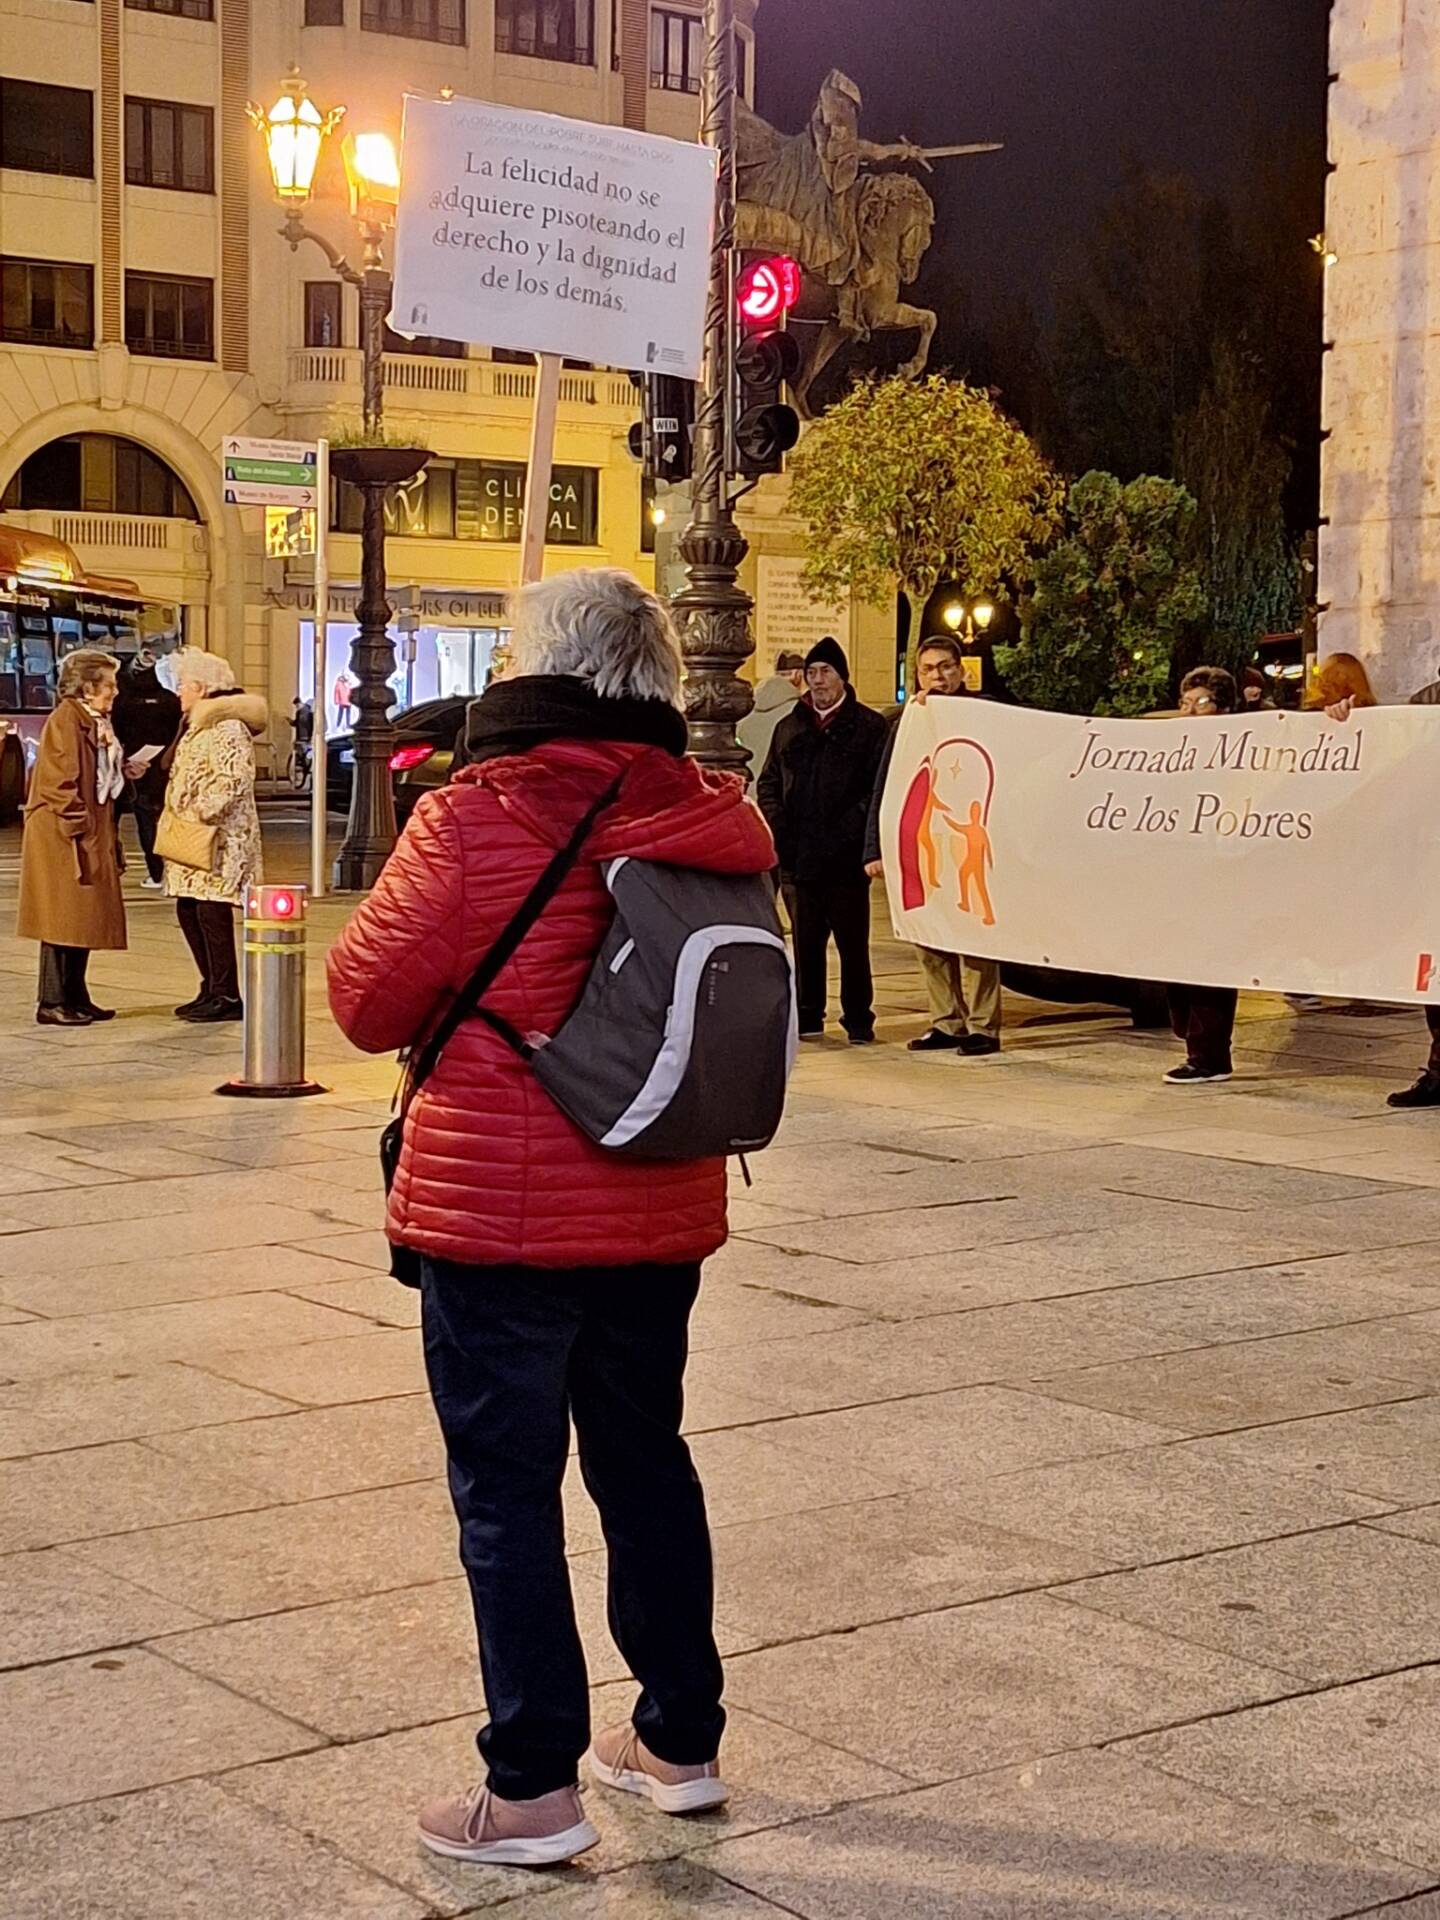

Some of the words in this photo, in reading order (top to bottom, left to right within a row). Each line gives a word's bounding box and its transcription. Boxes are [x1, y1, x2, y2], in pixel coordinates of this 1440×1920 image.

[464, 152, 493, 177] La
[501, 156, 600, 195] felicidad
[606, 181, 632, 202] no
[639, 189, 662, 209] se
[428, 185, 535, 219] adquiere
[541, 204, 661, 245] pisoteando
[667, 227, 686, 249] el
[433, 221, 530, 257] derecho
[536, 242, 551, 266] y
[557, 239, 576, 264] la
[583, 246, 678, 284] dignidad
[480, 265, 509, 290] de
[516, 269, 549, 296] los
[556, 277, 628, 313] demás.
[486, 476, 577, 503] CLÍCA
[485, 506, 577, 530] DENAL
[1070, 732, 1198, 779] Jornada
[1204, 729, 1364, 774] Mundial
[1086, 791, 1127, 831] de
[1133, 795, 1180, 833] los
[1189, 793, 1314, 840] Pobres
